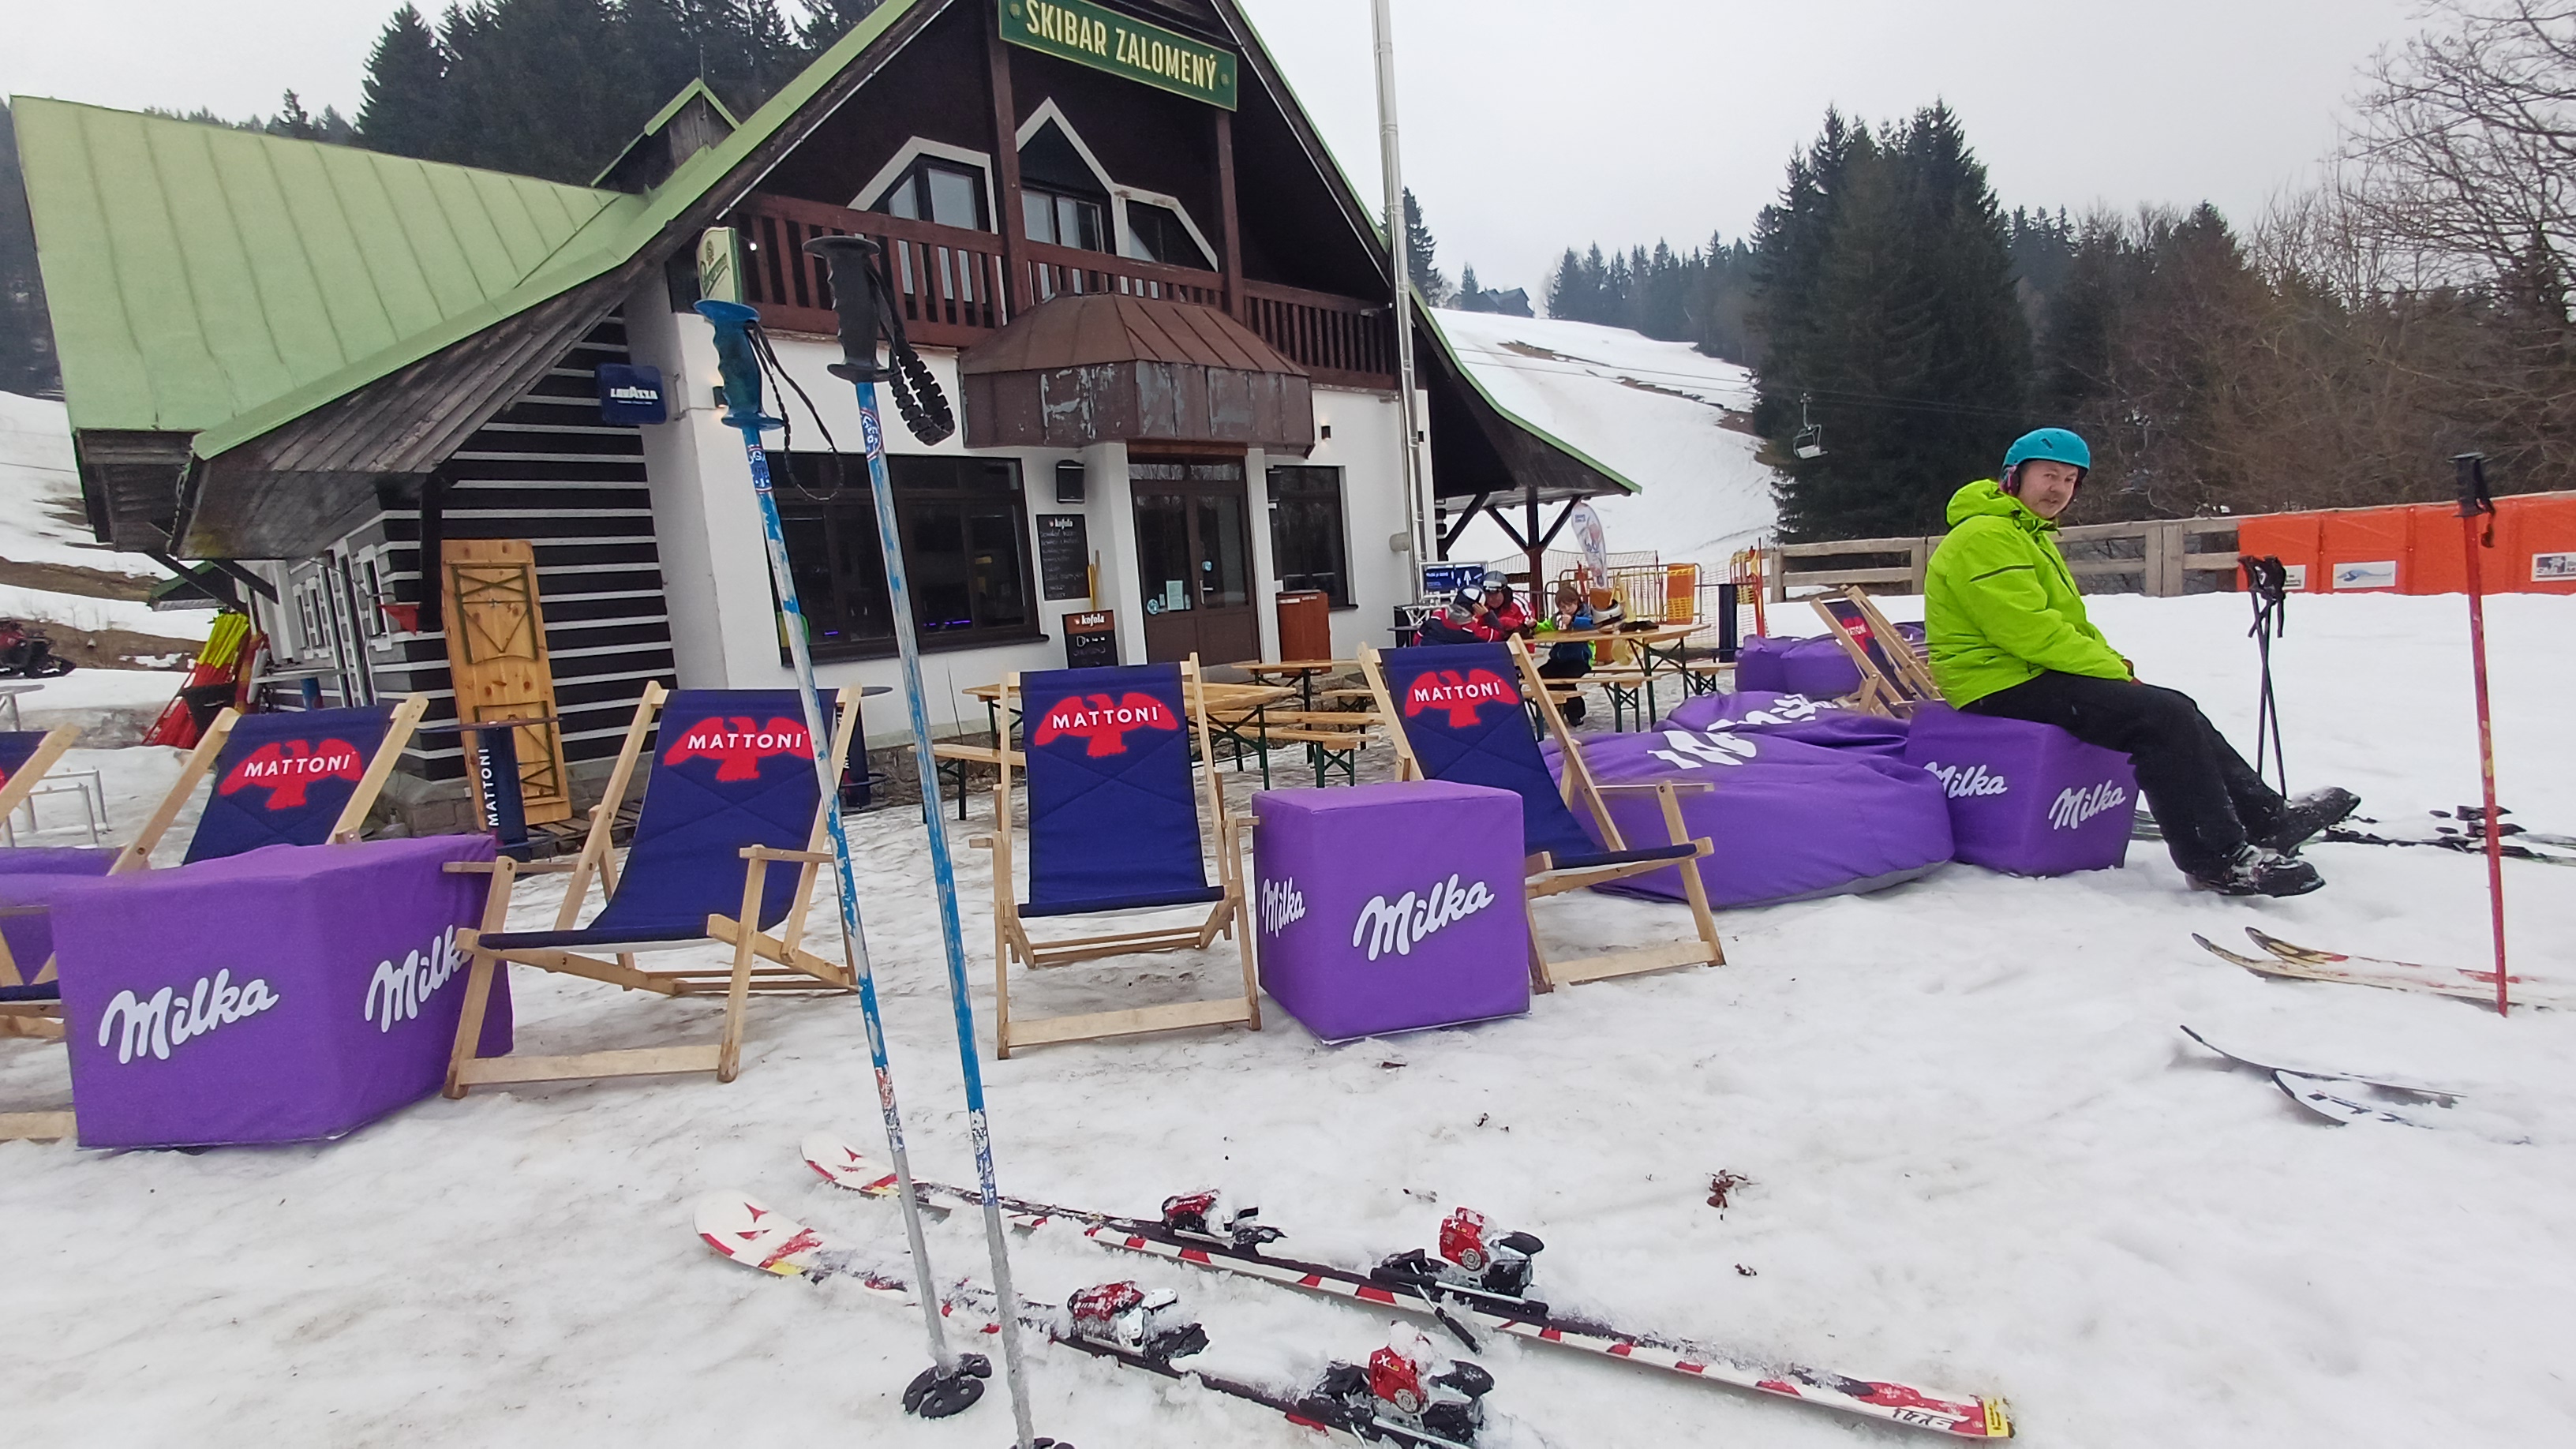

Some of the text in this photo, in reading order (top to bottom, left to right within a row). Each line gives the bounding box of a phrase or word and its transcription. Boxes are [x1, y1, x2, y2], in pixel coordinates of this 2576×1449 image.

[1115, 27, 1217, 91] ZALOMENÝ
[1081, 612, 1105, 627] kofola
[1052, 706, 1159, 730] MATTONI
[1414, 681, 1501, 702] MATTONI
[243, 754, 350, 777] MATTONI
[687, 732, 802, 750] MATTONI
[477, 748, 500, 827] MATTONI
[2048, 779, 2127, 831] Milka
[1262, 877, 1306, 938] Milka
[1353, 874, 1495, 962] Milka
[365, 924, 473, 1033] Milk
[98, 968, 280, 1065] Milka
